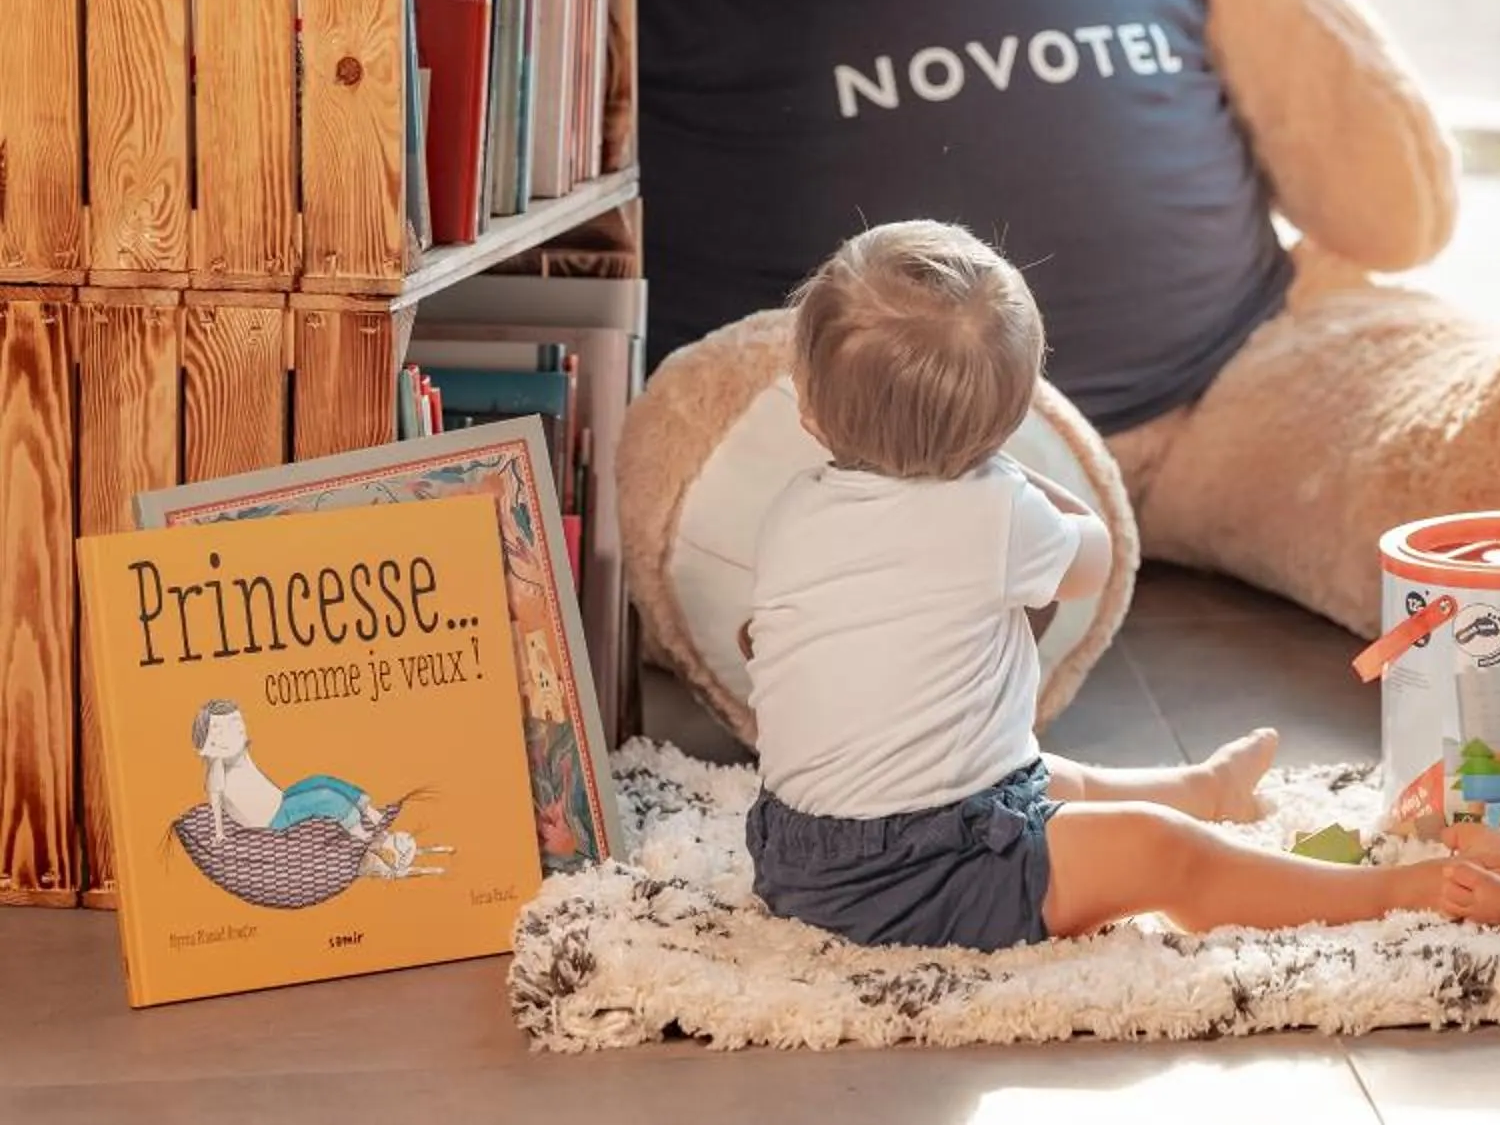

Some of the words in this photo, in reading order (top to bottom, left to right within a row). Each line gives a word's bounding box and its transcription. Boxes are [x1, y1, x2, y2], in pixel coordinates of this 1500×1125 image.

[833, 22, 1182, 118] NOVOTEL
[128, 551, 479, 667] Princesse...
[265, 664, 361, 707] comme
[368, 650, 392, 701] je
